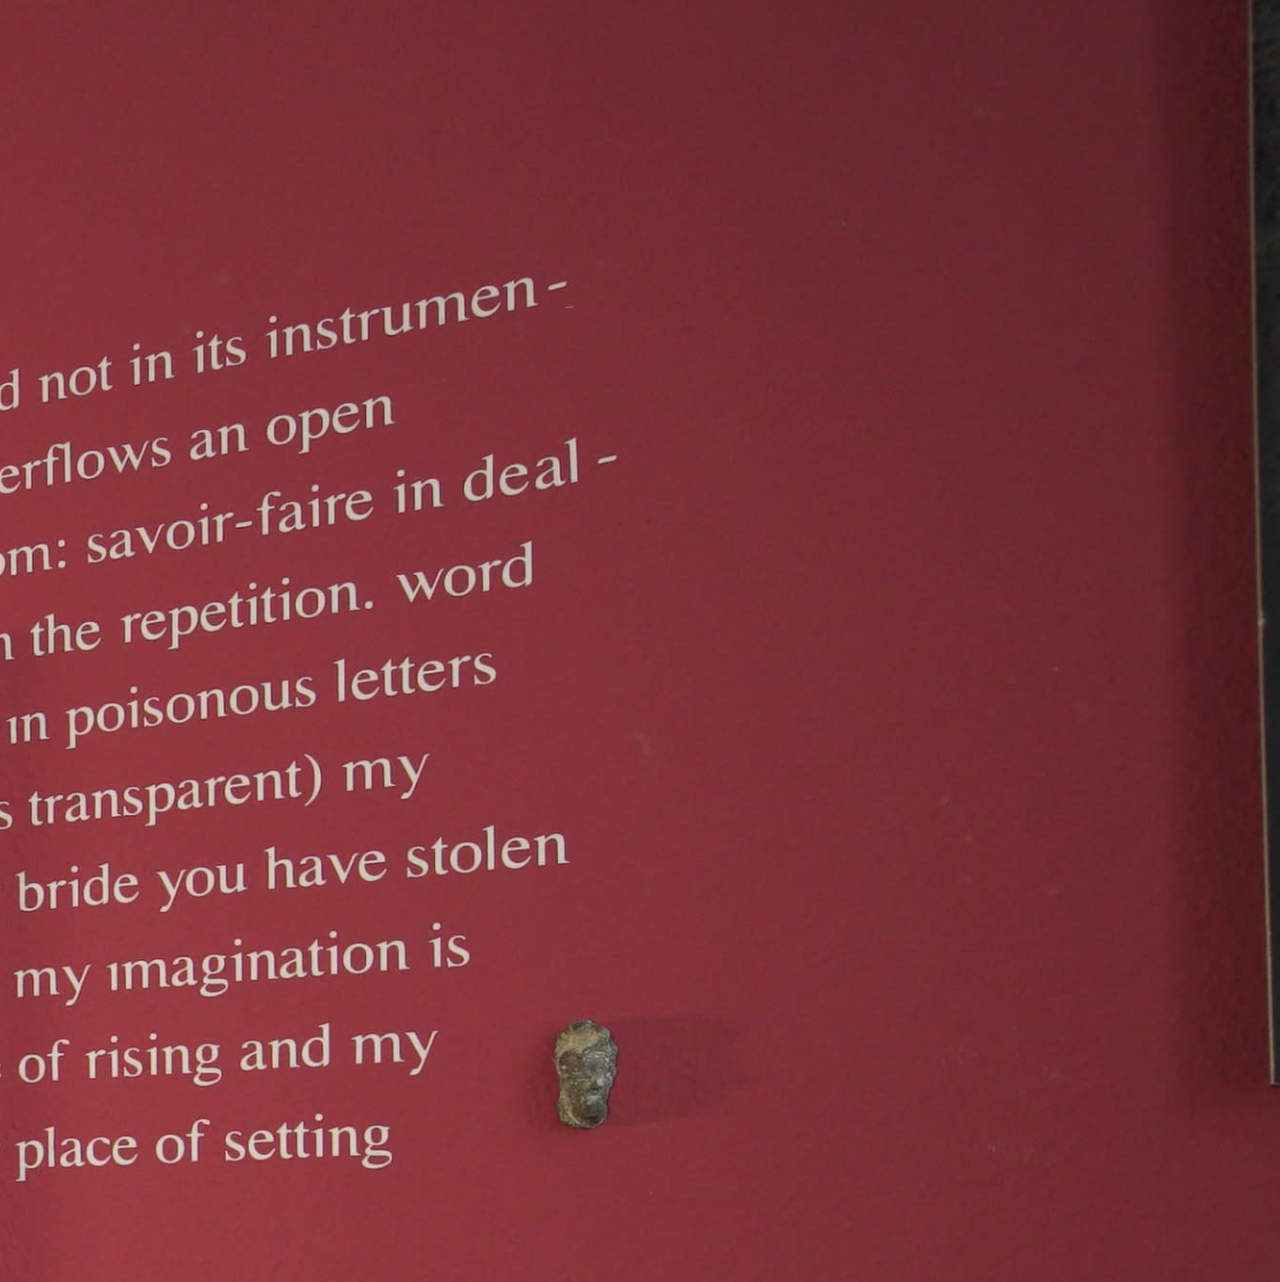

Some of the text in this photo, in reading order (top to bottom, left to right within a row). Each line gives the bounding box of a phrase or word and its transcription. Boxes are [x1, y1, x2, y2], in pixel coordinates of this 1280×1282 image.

[38, 356, 112, 402] not
[130, 343, 175, 385] in
[193, 331, 246, 373] its
[190, 424, 249, 460] an
[267, 396, 395, 454] open
[88, 484, 373, 563] savoir-faire
[393, 469, 444, 513] in
[30, 613, 101, 656] the
[120, 577, 373, 649] repetition.
[396, 541, 532, 602] word
[6, 712, 50, 744] in
[66, 677, 316, 749] poisonous
[334, 653, 496, 702] letters
[28, 754, 321, 826] transparent)
[342, 753, 430, 799] my
[16, 863, 139, 911] bride
[157, 864, 247, 912] you
[264, 846, 387, 889] have
[407, 825, 570, 878] stolen
[14, 964, 91, 1006] my
[107, 931, 410, 997] imagination
[429, 922, 470, 968] is
[19, 1039, 70, 1083] of
[85, 1033, 222, 1086] rising
[240, 1023, 330, 1071] and
[352, 1030, 439, 1075] my
[16, 1126, 138, 1182] place
[156, 1119, 210, 1164] of
[225, 1113, 392, 1169] setting
